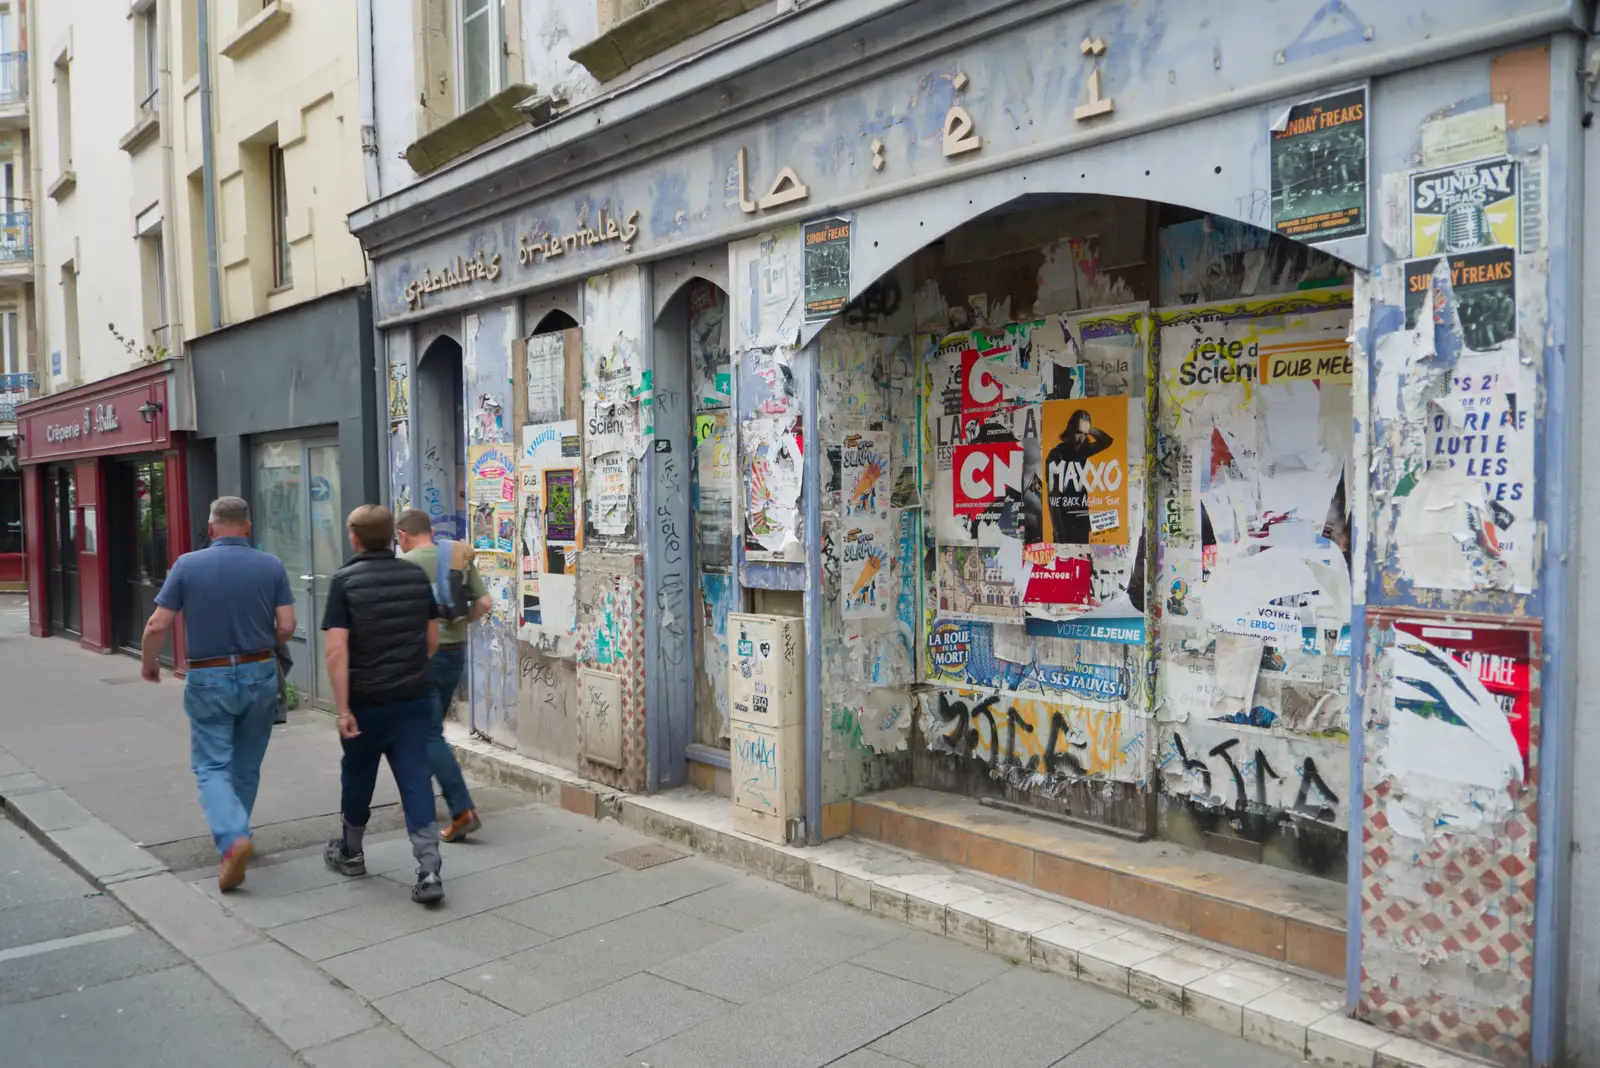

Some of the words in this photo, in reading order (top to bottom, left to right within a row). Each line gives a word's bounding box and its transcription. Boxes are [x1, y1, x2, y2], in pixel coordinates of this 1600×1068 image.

[1320, 103, 1365, 129] FREAKS
[1453, 165, 1477, 177] THE
[1416, 164, 1513, 209] SUNDAY
[1437, 185, 1487, 213] FREAKS
[1462, 260, 1513, 285] FREAKS
[1272, 360, 1312, 378] DUB
[46, 420, 80, 443] Crêperie
[844, 449, 873, 469] SLAM
[523, 474, 537, 487] DUB
[1048, 457, 1122, 494] MAXXO
[1049, 496, 1061, 507] WE
[1062, 496, 1080, 507] BACK
[1081, 494, 1103, 507] AGAIN
[1104, 495, 1121, 506] TOUR
[844, 542, 872, 562] SLAM
[1051, 571, 1071, 580] TOUR
[1257, 607, 1291, 620] VOTRE
[928, 634, 942, 646] LA
[943, 631, 971, 644] ROUE
[1056, 622, 1090, 637] VOTEZ
[1090, 627, 1141, 641] LEJEUNE
[950, 643, 958, 651] LA
[935, 651, 964, 665] MORT
[1050, 671, 1071, 686] SES
[1071, 675, 1117, 695] FAUVES
